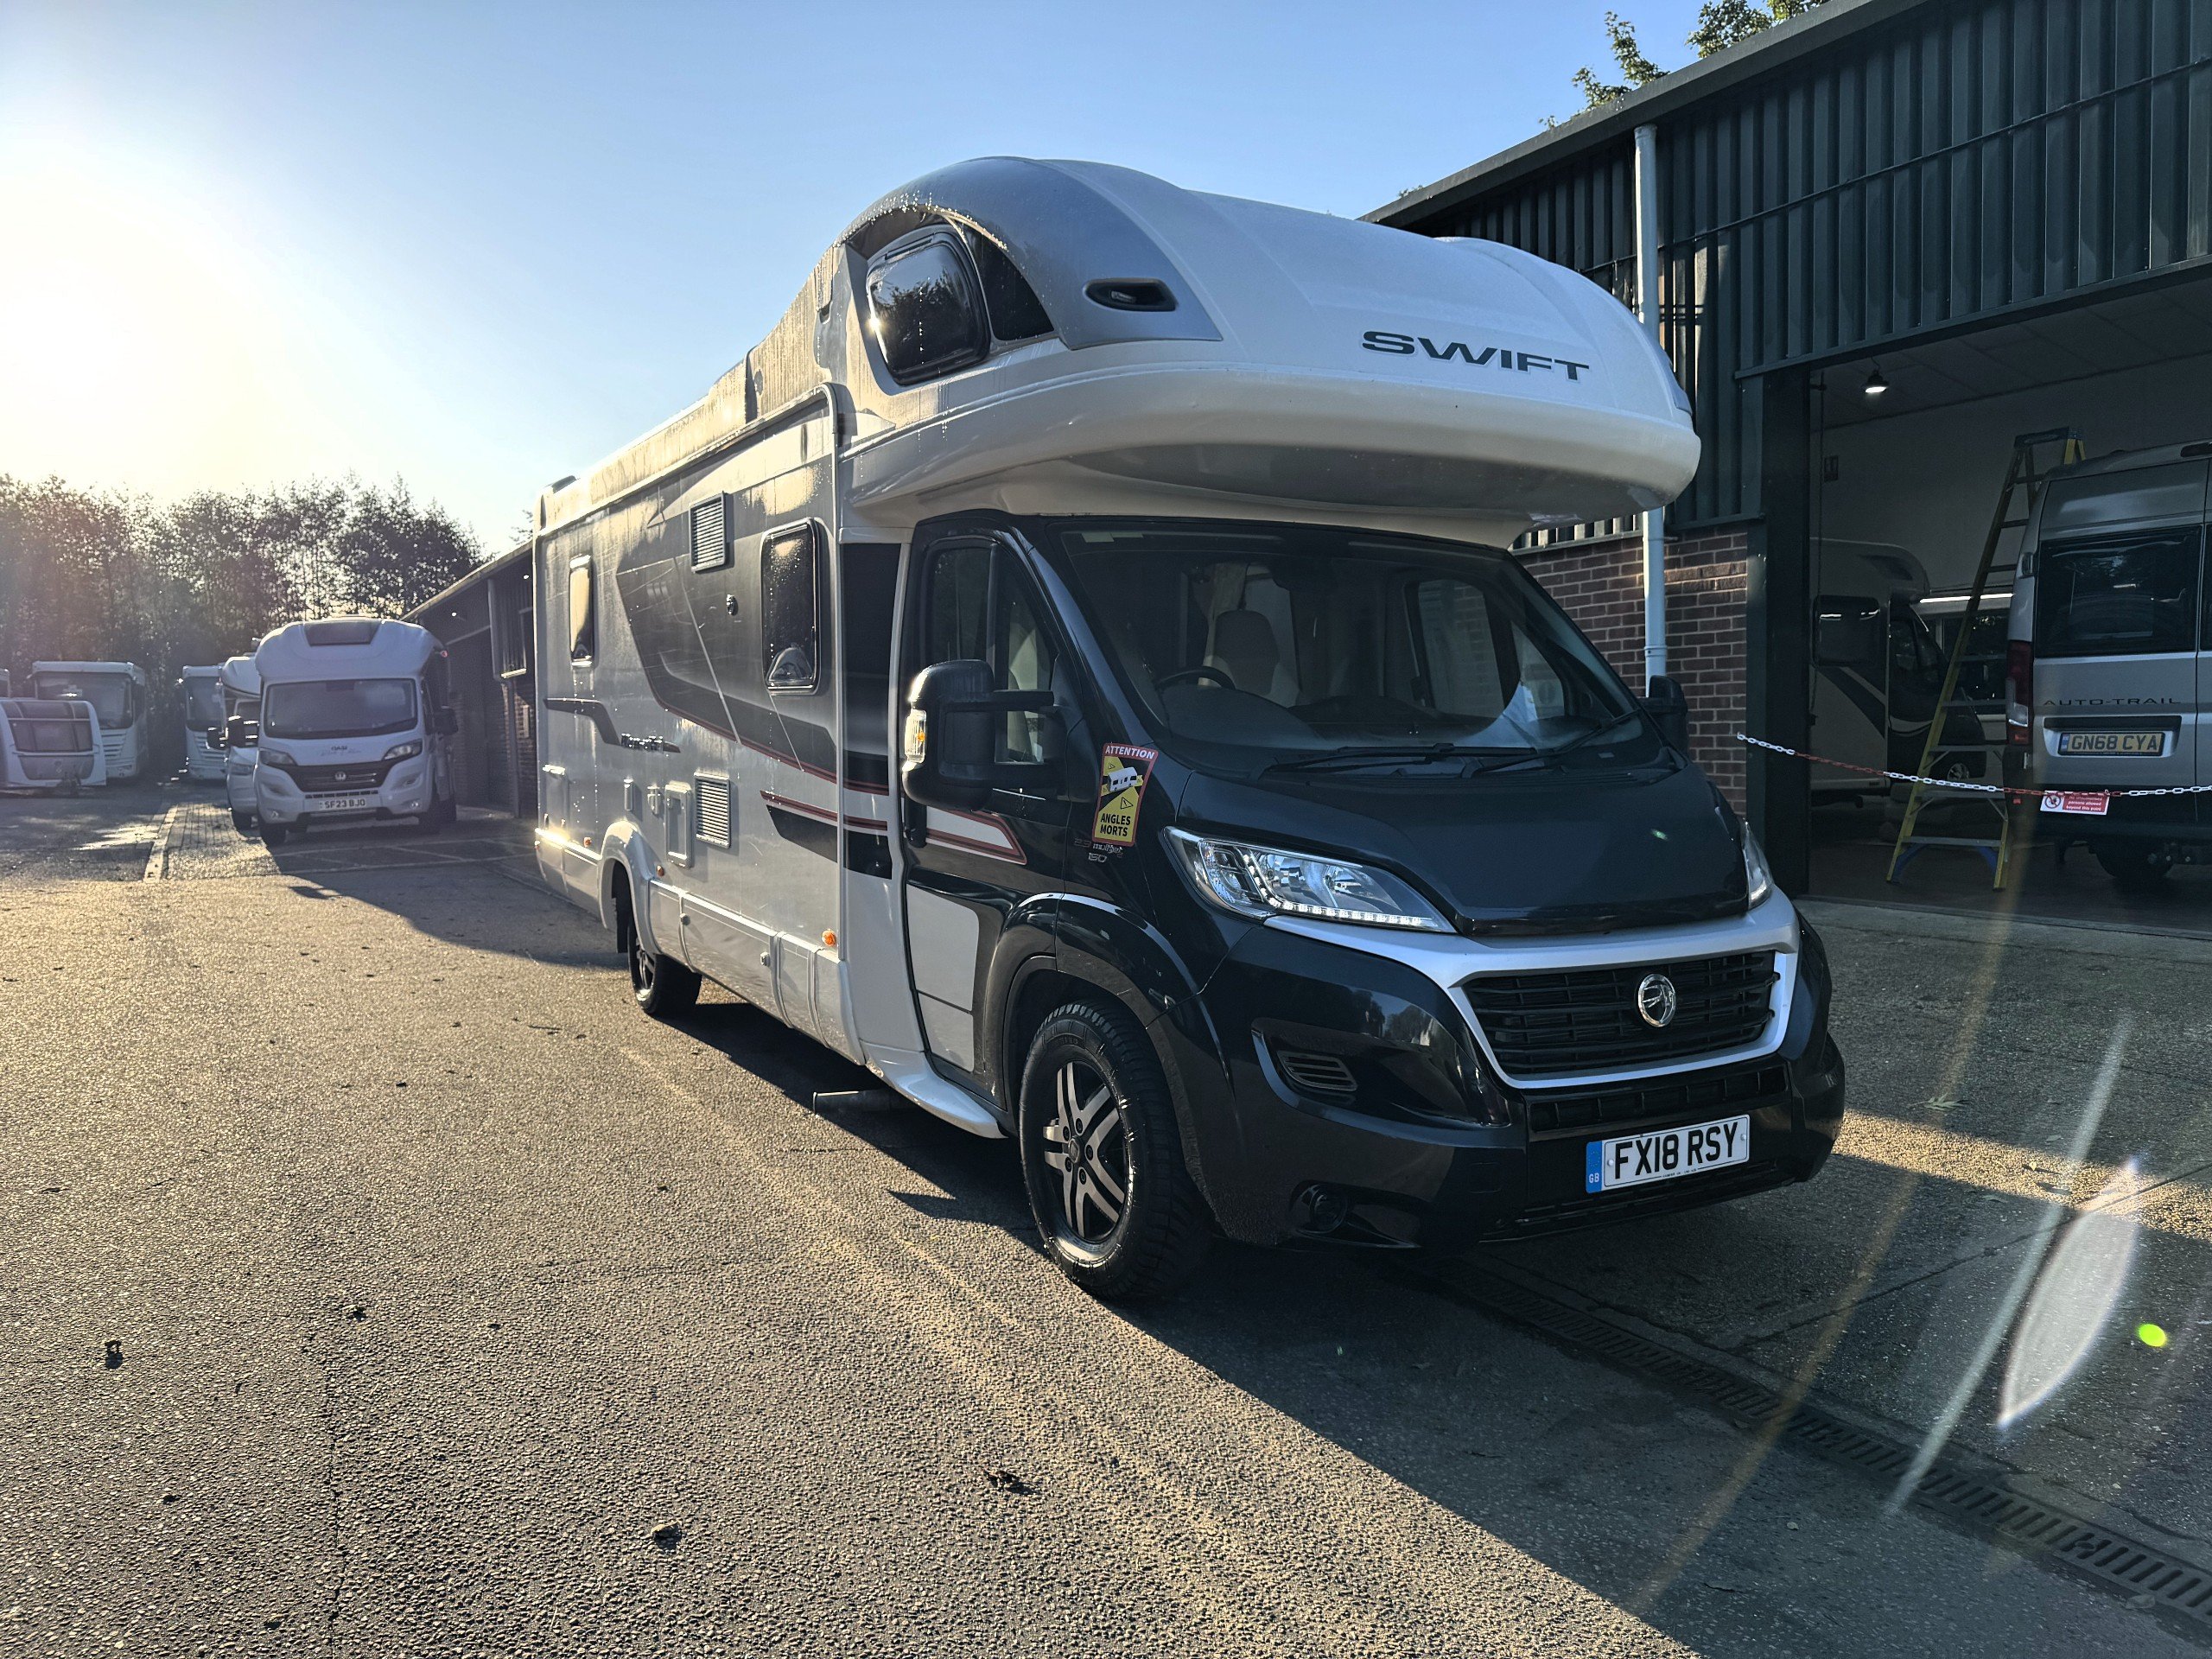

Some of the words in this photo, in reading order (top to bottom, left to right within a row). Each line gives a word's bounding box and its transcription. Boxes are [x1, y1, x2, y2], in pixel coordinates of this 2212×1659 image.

[1362, 330, 1590, 381] SWIFT
[2044, 697, 2182, 706] AUTO-TRAIL
[2071, 734, 2119, 750] GN68
[2122, 734, 2158, 750] CYA
[1105, 745, 1155, 760] ATTENTION
[1100, 813, 1131, 826] ANGLES
[1100, 824, 1128, 837] MORTS
[1614, 1134, 1679, 1179] FX18
[1688, 1122, 1738, 1166] RSY
[1588, 1172, 1599, 1184] GB
